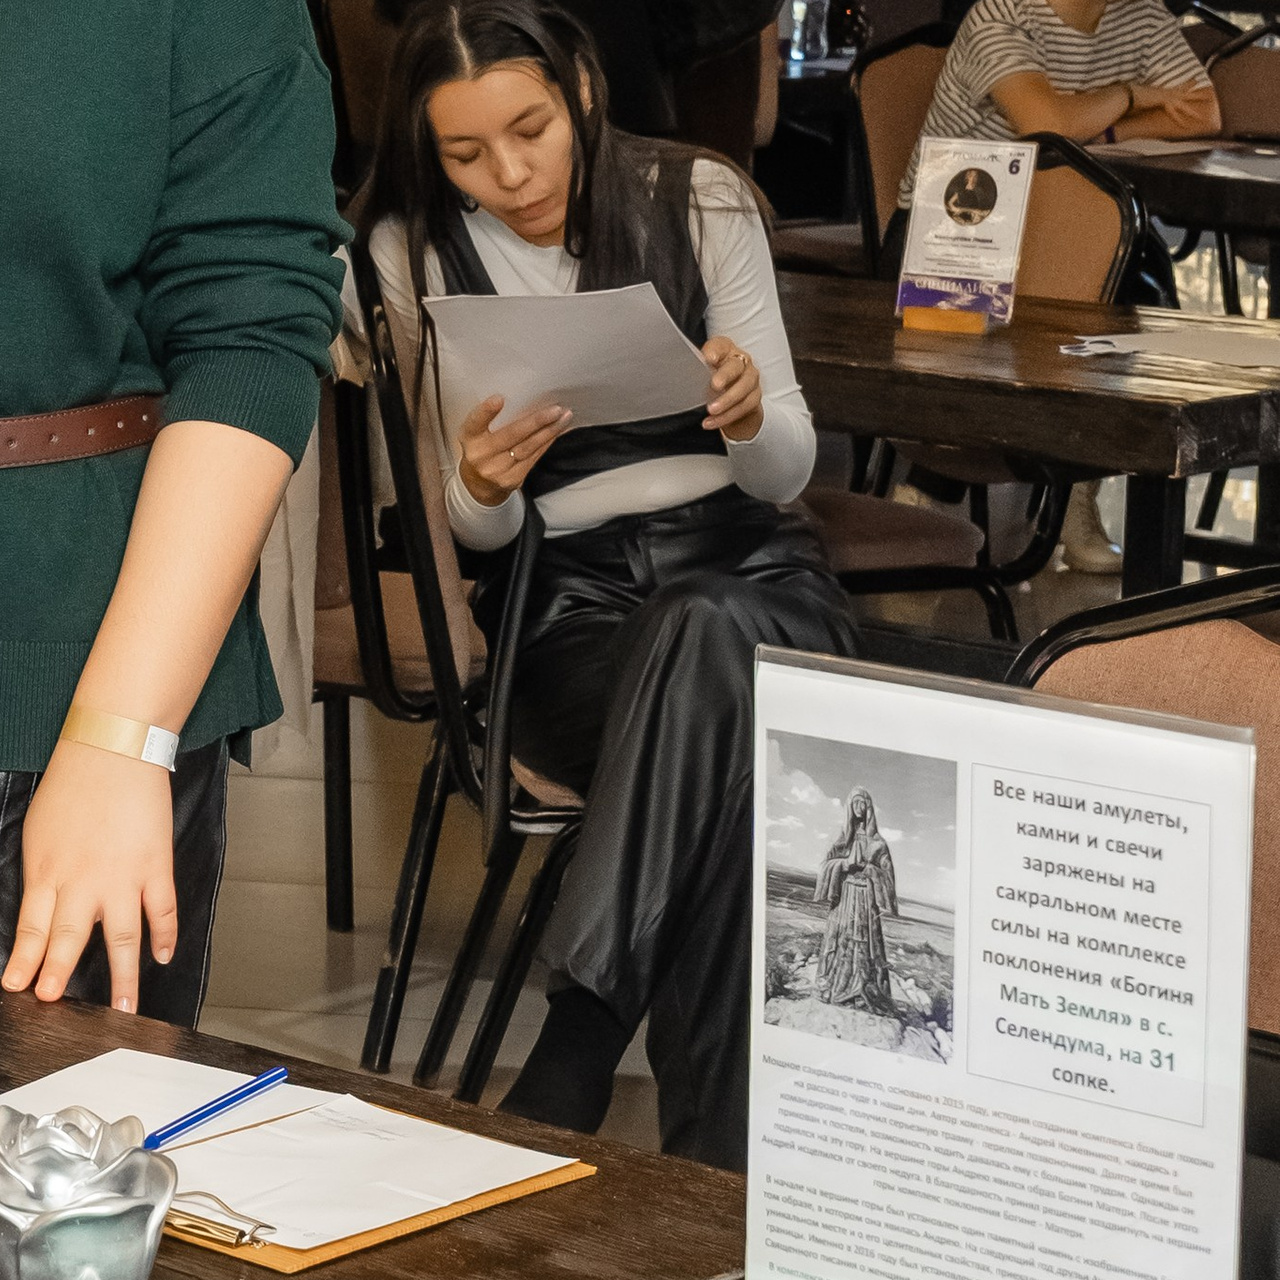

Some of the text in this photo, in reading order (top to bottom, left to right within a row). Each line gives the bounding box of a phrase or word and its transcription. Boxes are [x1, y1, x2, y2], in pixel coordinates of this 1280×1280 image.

[1008, 159, 1021, 175] 6
[993, 779, 1188, 834] Все наши амулеты,
[1016, 822, 1164, 861] камни и свечи
[1022, 856, 1156, 894] заряжены на
[995, 885, 1183, 934] сакральном месте
[990, 917, 1187, 970] силы на комплексе
[982, 949, 1194, 1006] поклонения «Богиня
[1000, 983, 1173, 1037] Мать Земля» в с.
[995, 1016, 1175, 1072] Селендума, на 31
[1051, 1067, 1115, 1094] сопке.
